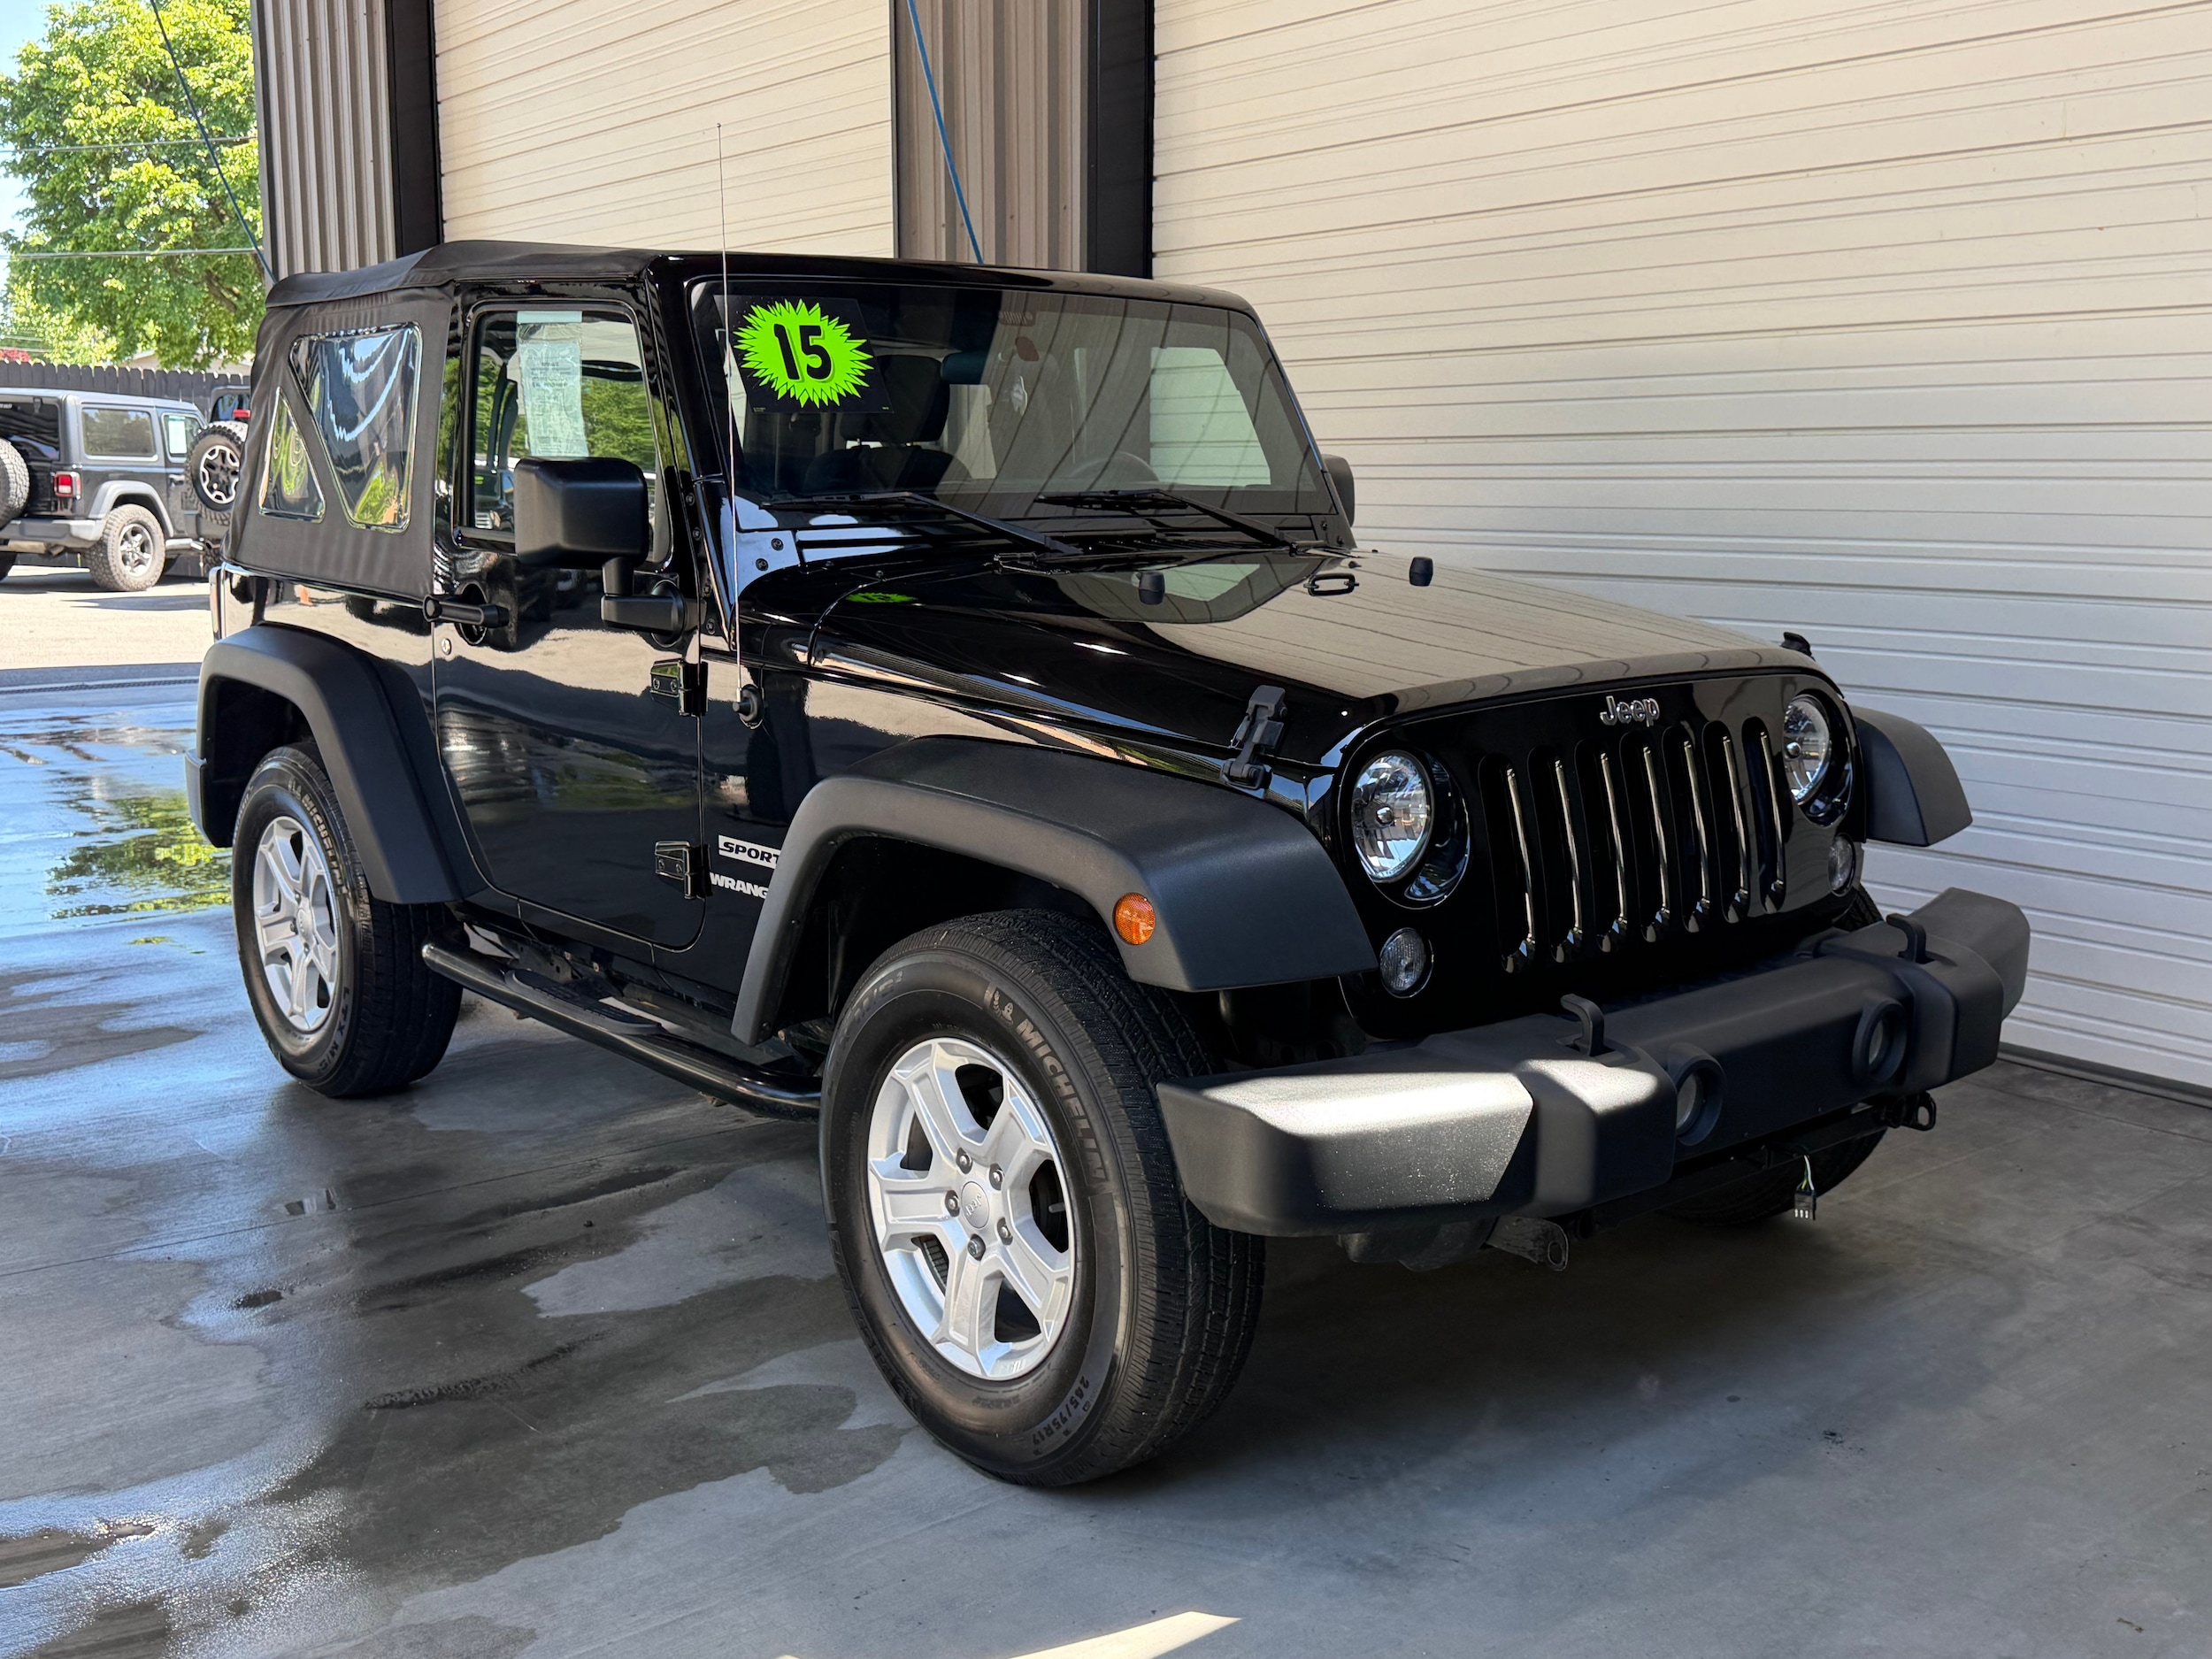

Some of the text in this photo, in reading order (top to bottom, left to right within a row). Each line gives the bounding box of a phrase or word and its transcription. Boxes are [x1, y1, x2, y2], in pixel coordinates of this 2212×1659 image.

[773, 323, 834, 382] 15
[1600, 695, 1660, 727] Jeep
[1018, 1018, 1106, 1180] MICHELIN
